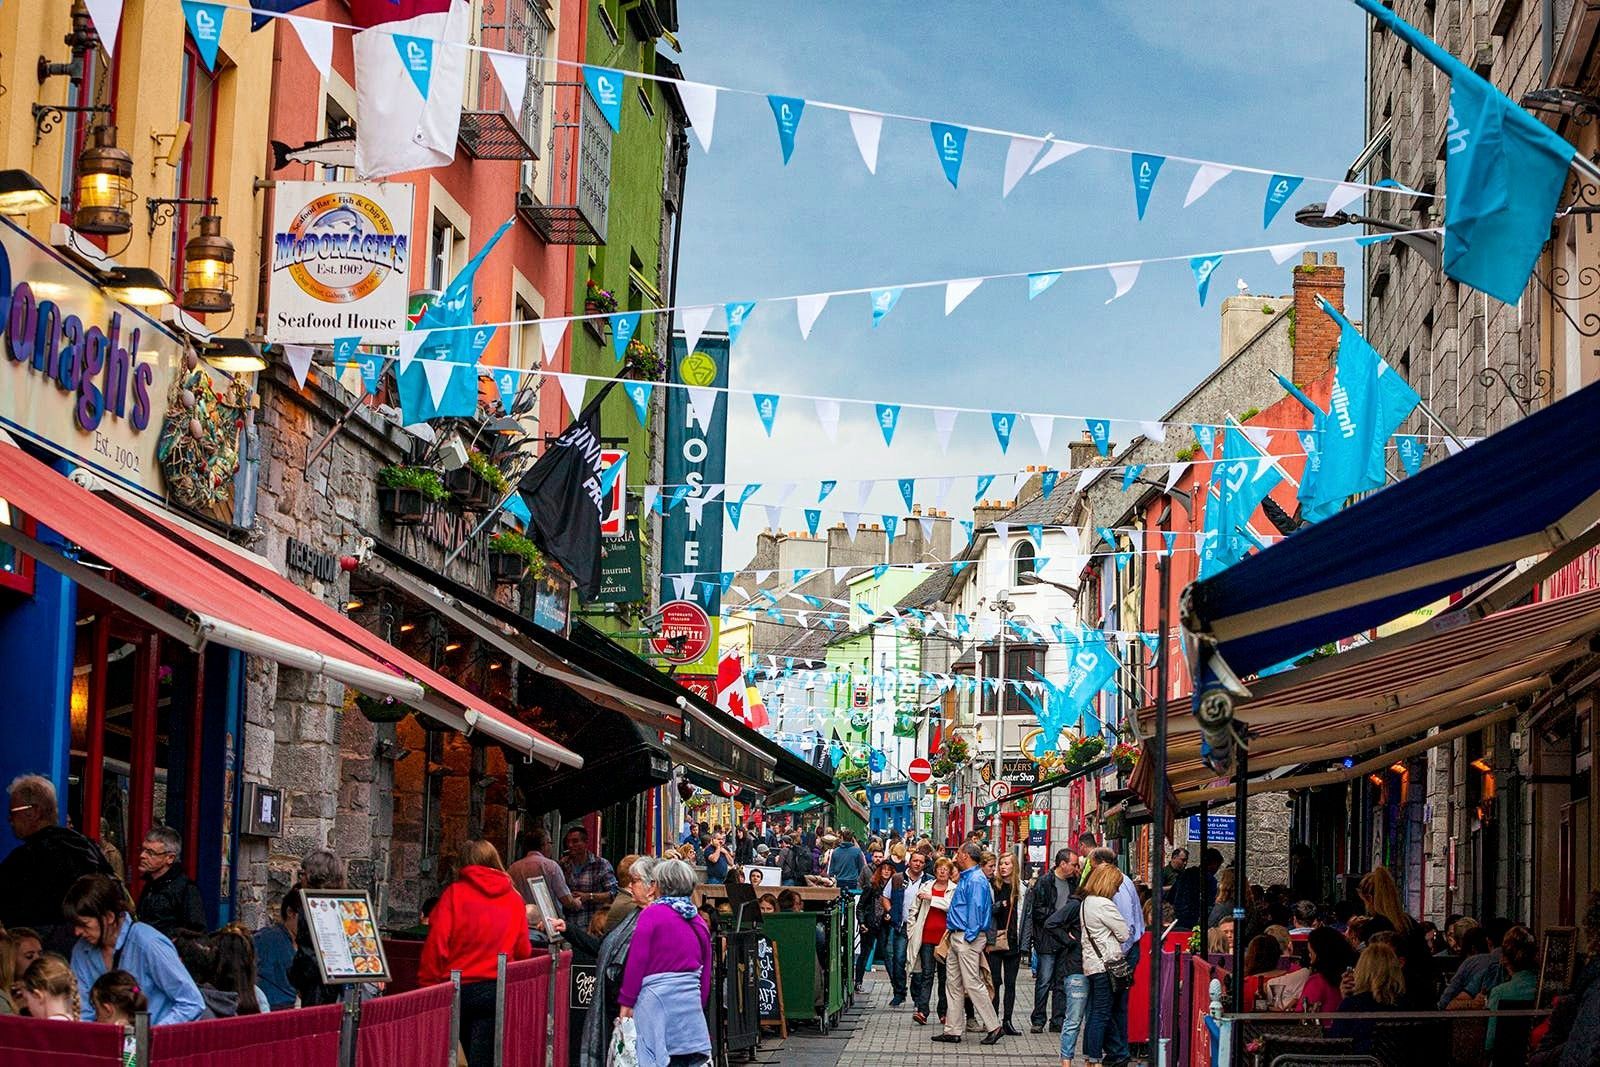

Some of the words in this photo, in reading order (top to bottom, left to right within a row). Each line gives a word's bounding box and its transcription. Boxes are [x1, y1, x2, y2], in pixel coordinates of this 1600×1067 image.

[293, 205, 317, 231] Seafood
[317, 199, 331, 210] Bar
[338, 196, 354, 205] Fish
[356, 199, 363, 207] &
[364, 203, 381, 219] Chip
[379, 215, 390, 232] Bar
[316, 263, 337, 275] Est.
[339, 264, 363, 276] 1902
[277, 311, 341, 329] Seafood
[348, 313, 397, 330] House
[0, 240, 152, 431] onagh's
[93, 430, 112, 458] Est.
[115, 444, 141, 474] 1902
[288, 539, 337, 581] RECEPTION
[602, 566, 631, 575] taurant
[605, 575, 614, 585] &
[600, 584, 626, 593] izzeria
[1003, 763, 1032, 771] ALLER'S
[1001, 773, 1019, 782] eater
[1019, 772, 1035, 782] Shop
